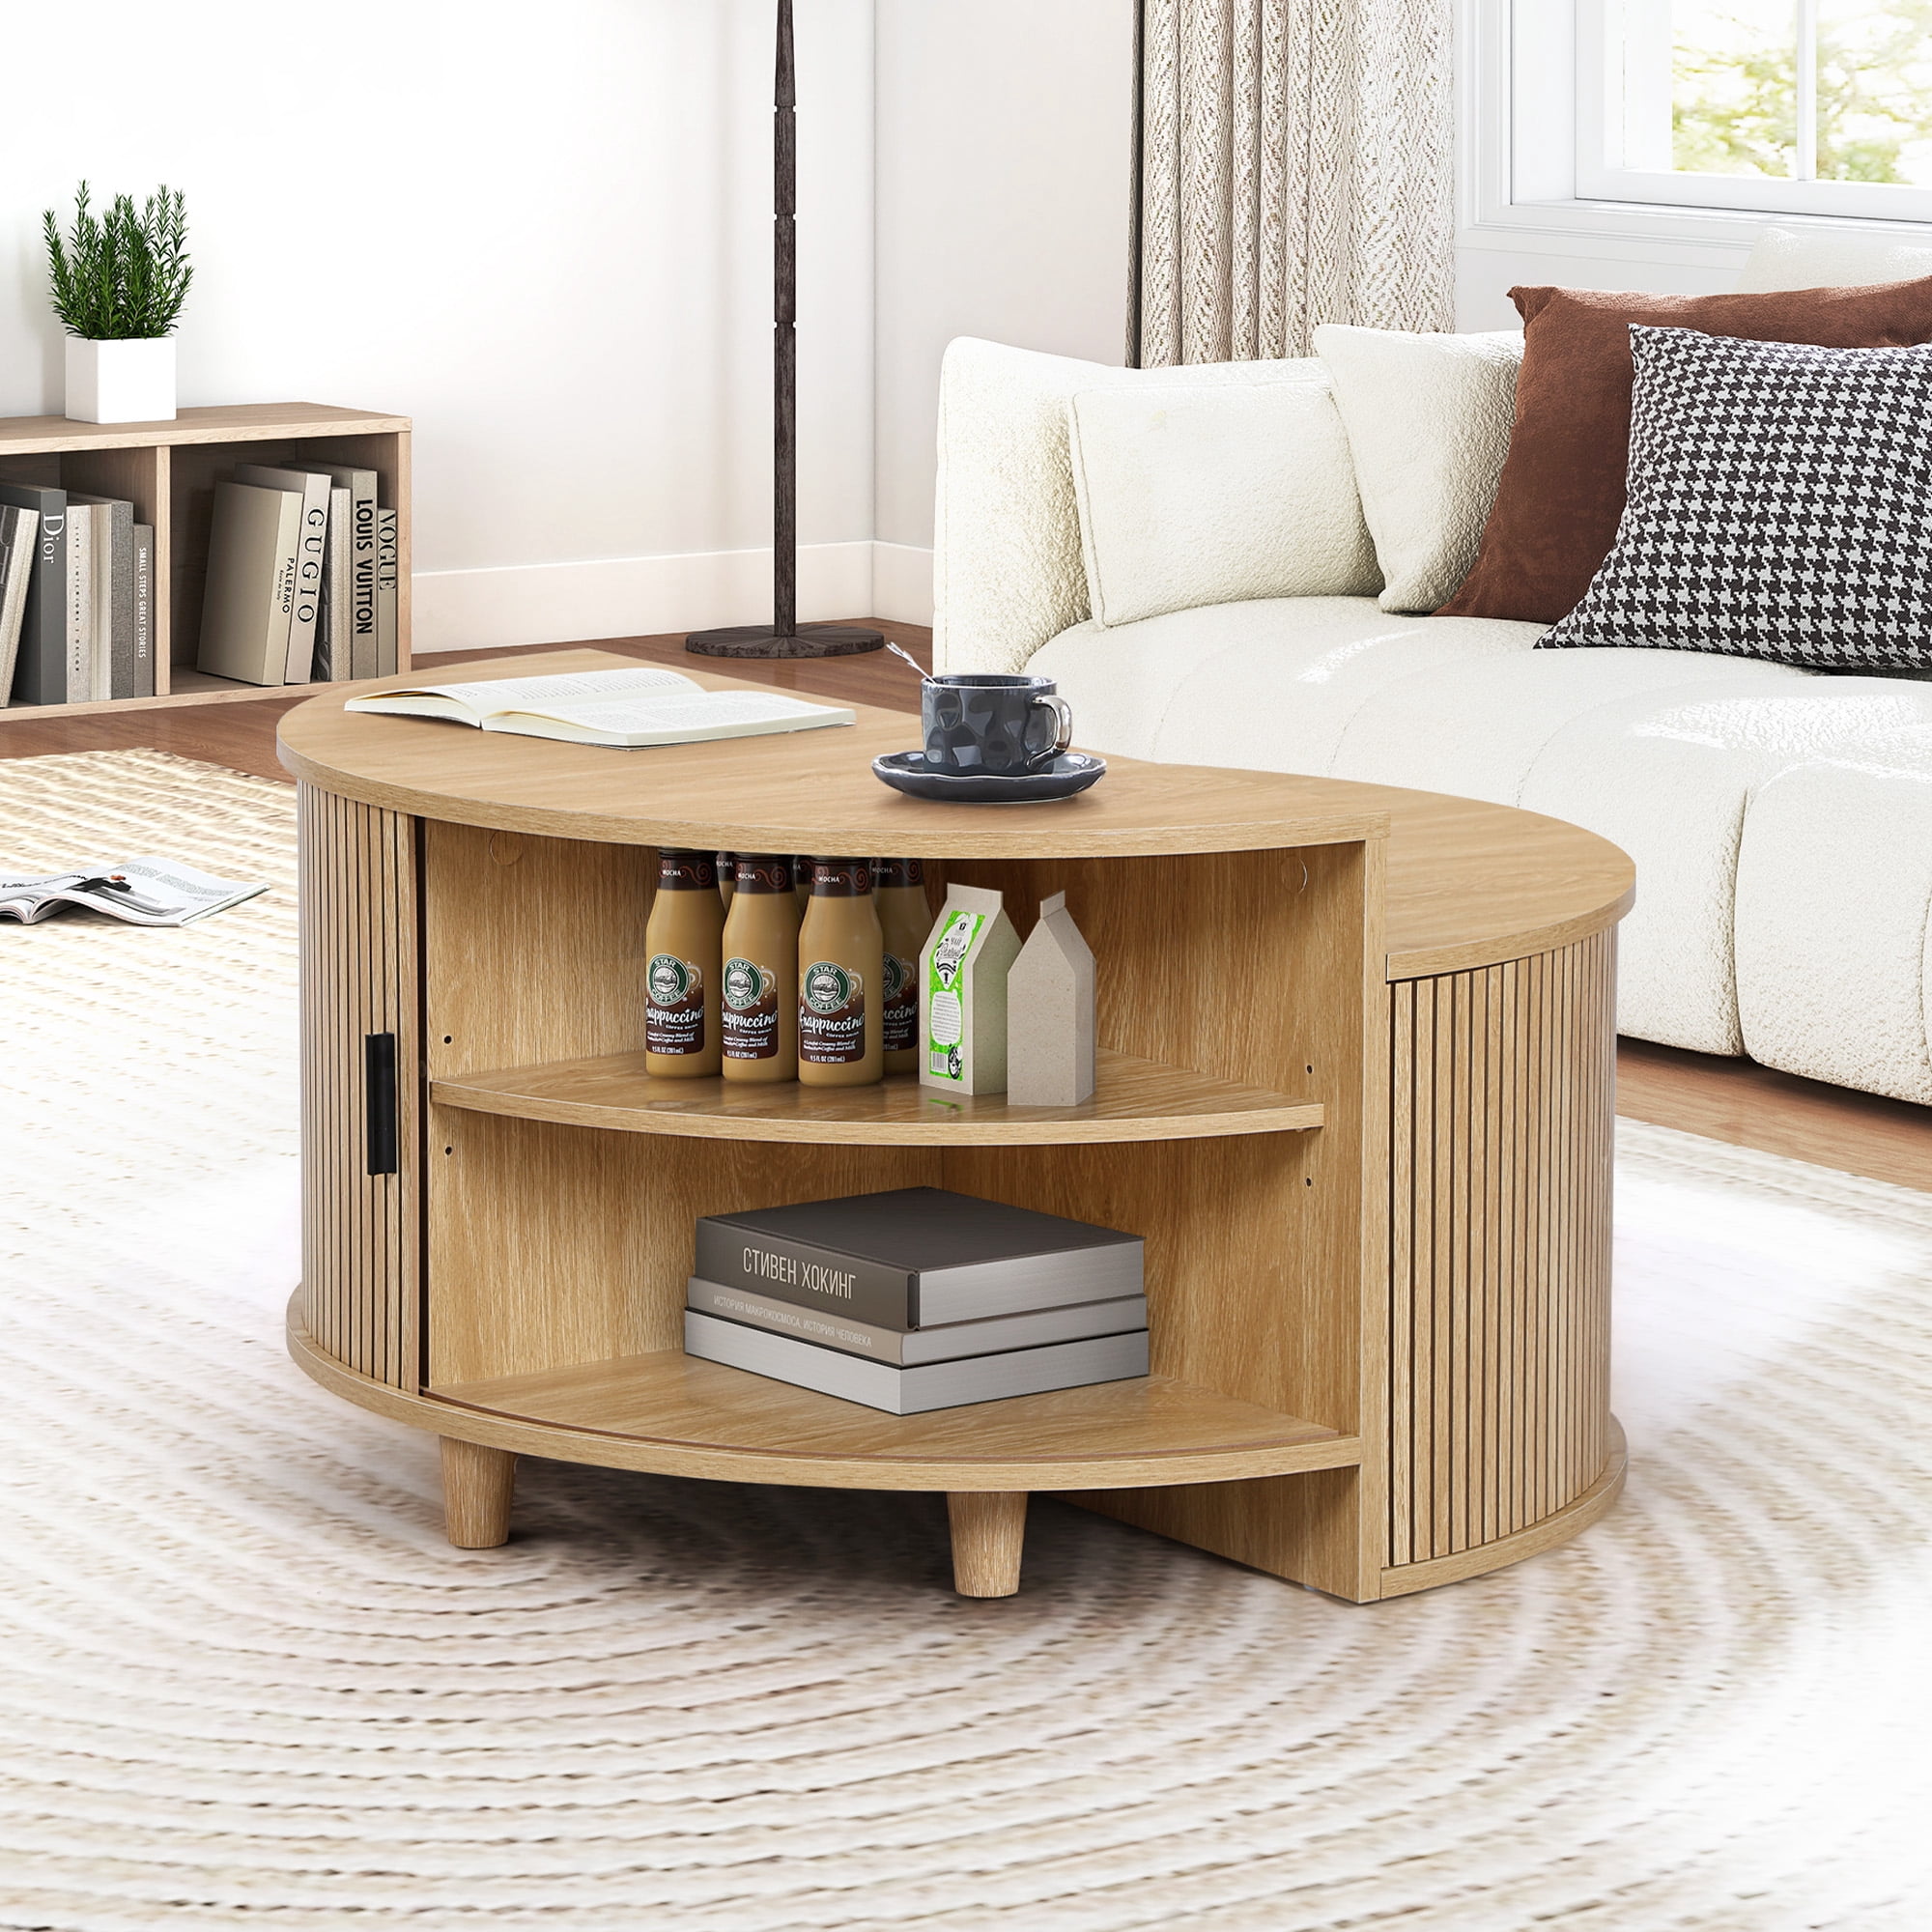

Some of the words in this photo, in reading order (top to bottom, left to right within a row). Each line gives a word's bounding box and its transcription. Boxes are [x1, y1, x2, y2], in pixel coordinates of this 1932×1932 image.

[43, 512, 65, 564] Dior
[356, 499, 373, 551] LOUIS
[138, 547, 147, 573] SMALL
[298, 508, 325, 622] GUGIO
[379, 513, 396, 590] VOGUE
[138, 575, 147, 598] STEPS
[282, 557, 295, 613] PALERMO
[356, 558, 373, 634] VUITTON
[138, 601, 147, 625] GREAT
[138, 627, 147, 658] STORIES
[654, 958, 676, 968] STAR
[729, 962, 750, 972] STAR
[813, 966, 838, 975] STAR
[743, 1247, 797, 1285] СТИВЕН
[801, 1262, 857, 1299] ХОКИНГ
[714, 1294, 745, 1312] ИСТОРИЯ
[803, 1319, 836, 1338] ИСТОРИЯ
[836, 1328, 872, 1348] ЧЕЛОВЕКА
